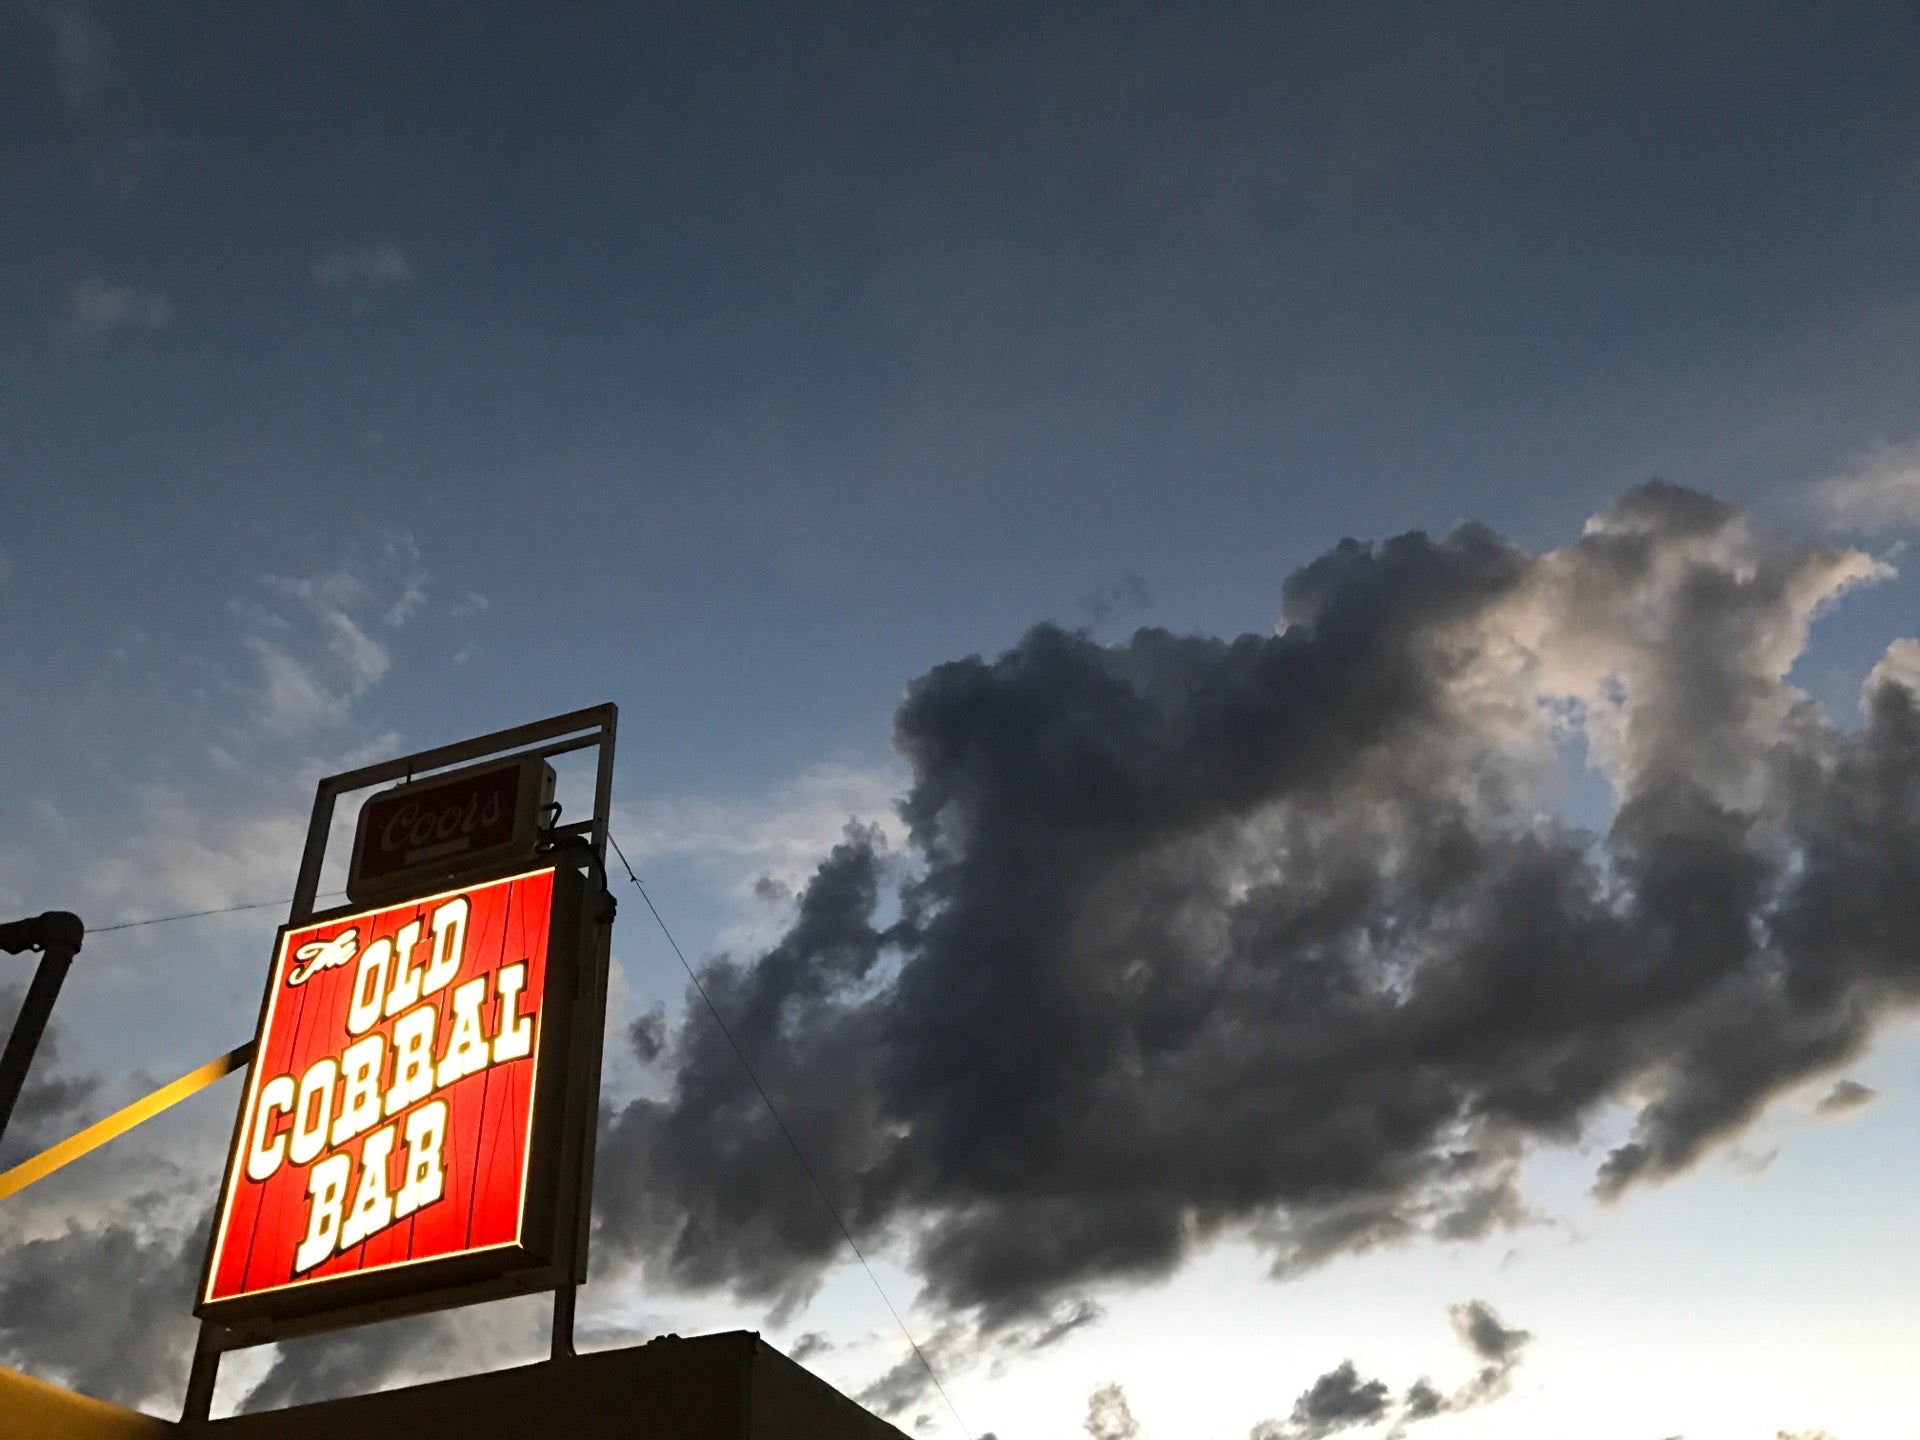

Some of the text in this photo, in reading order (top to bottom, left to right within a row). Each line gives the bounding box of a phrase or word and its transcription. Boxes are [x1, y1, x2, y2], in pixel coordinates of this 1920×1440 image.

[378, 787, 503, 853] Coors
[287, 896, 470, 1036] The OLD
[246, 963, 533, 1181] CORRAL
[295, 1100, 447, 1273] BAR
